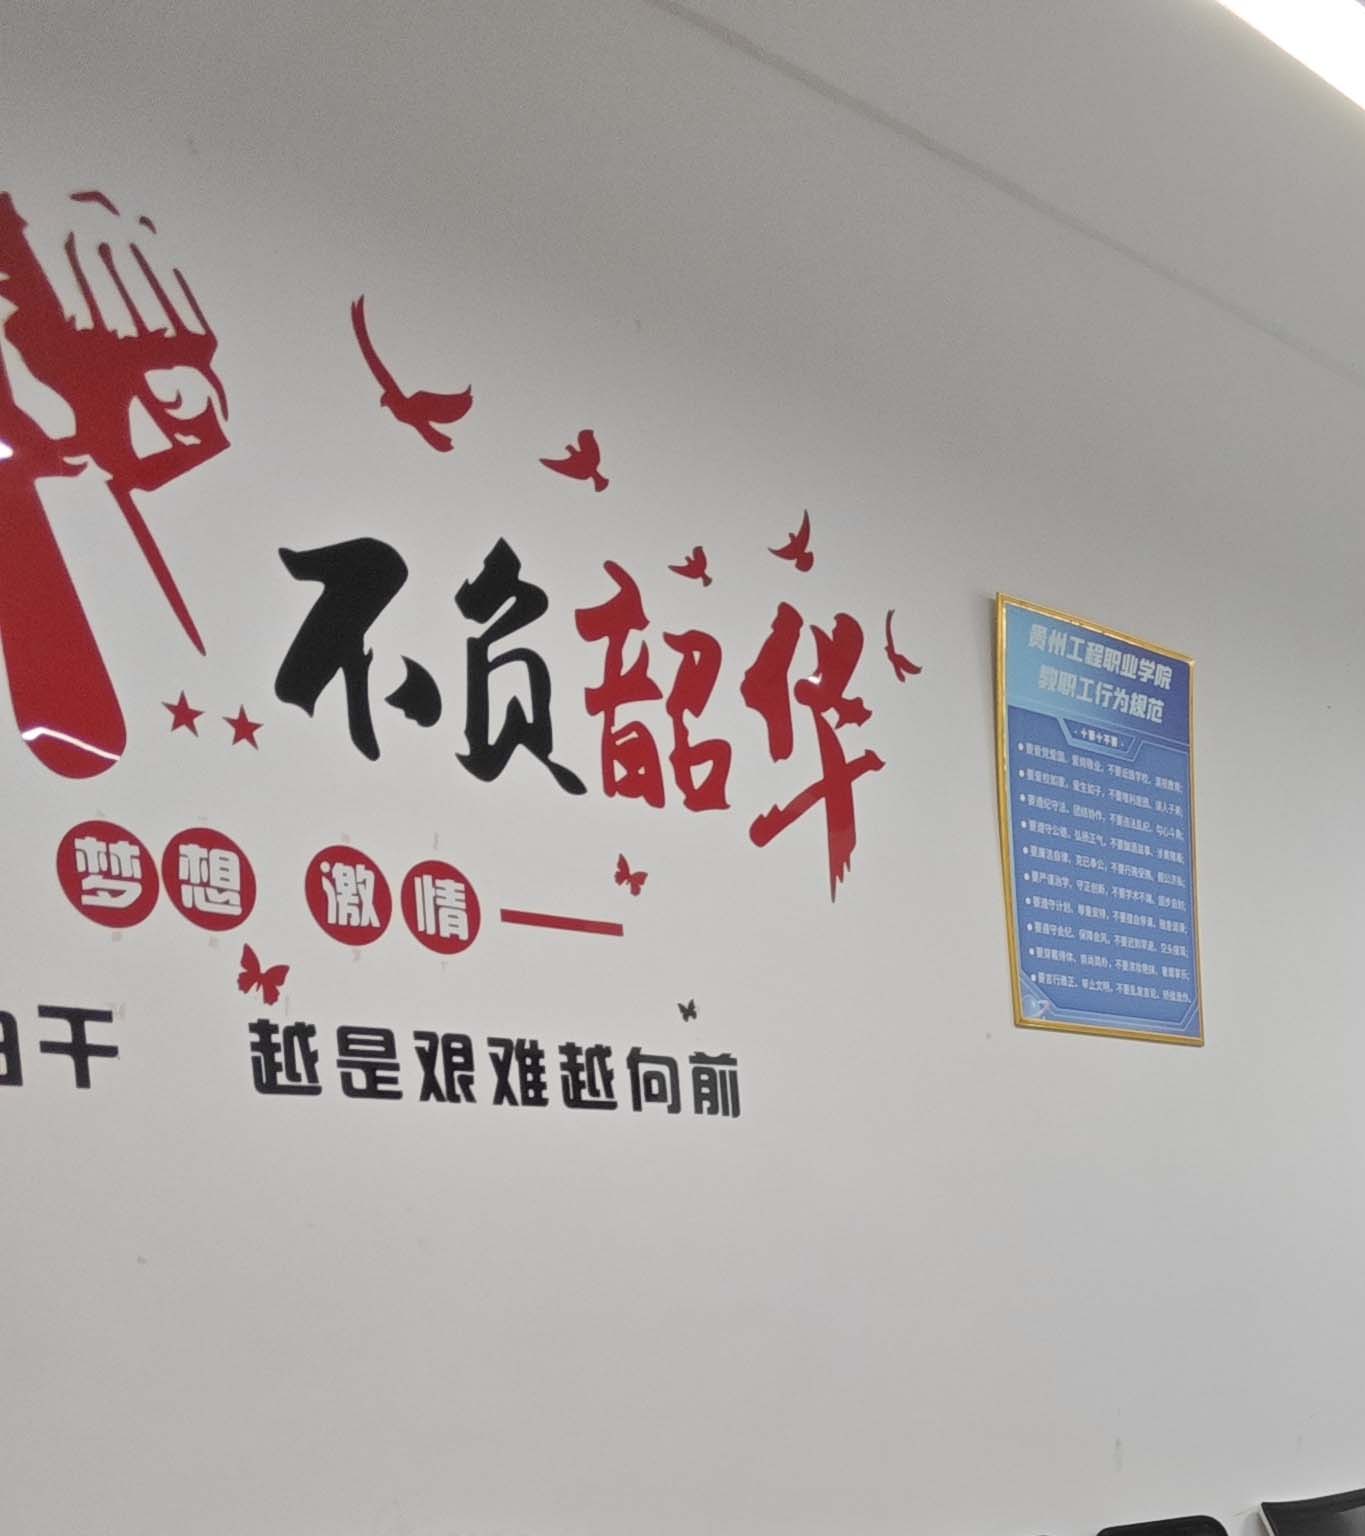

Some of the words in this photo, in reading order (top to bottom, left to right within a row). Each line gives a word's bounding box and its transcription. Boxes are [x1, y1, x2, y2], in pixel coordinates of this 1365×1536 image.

[1028, 623, 1173, 690] 贵州工程职业学院
[1037, 664, 1166, 724] 教职工行为规范
[74, 836, 245, 917] 梦想
[318, 861, 471, 940] 激情
[248, 1016, 741, 1120] 越是艰难越向前
